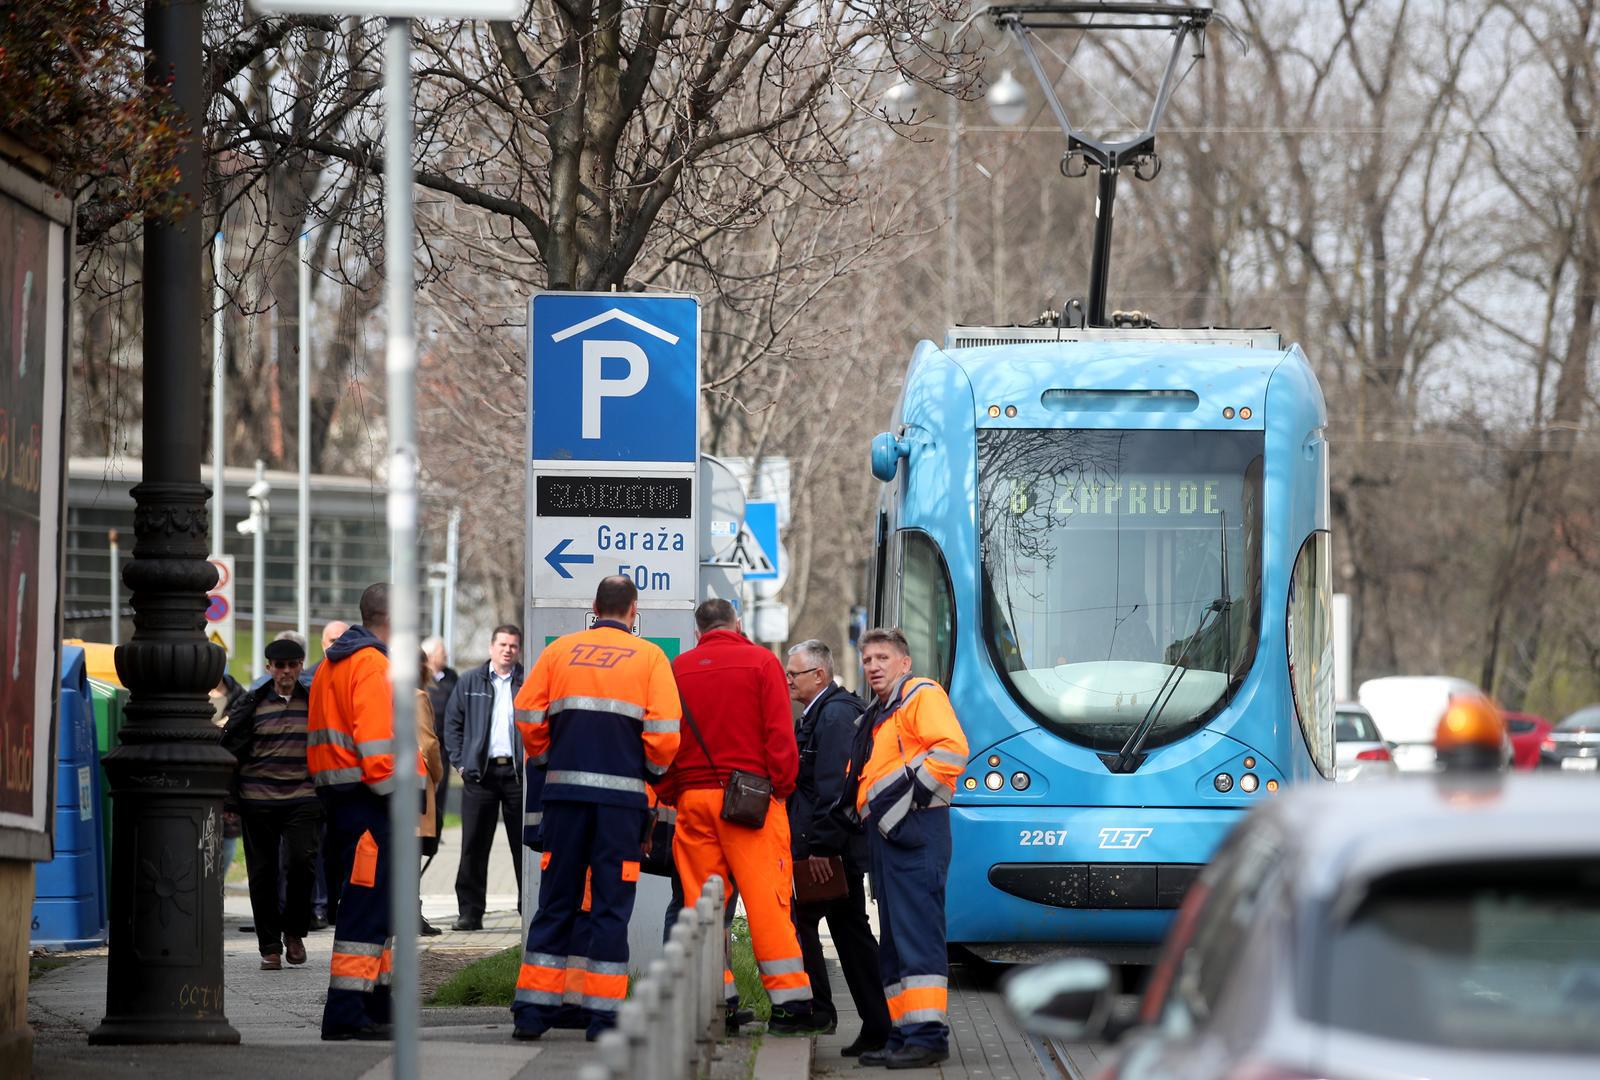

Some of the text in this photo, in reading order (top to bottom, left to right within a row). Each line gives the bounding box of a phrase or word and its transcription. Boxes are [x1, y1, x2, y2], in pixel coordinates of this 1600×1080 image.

[582, 340, 650, 439] P
[597, 524, 684, 551] Garaža
[569, 643, 637, 669] ZET
[1019, 830, 1068, 846] 2267
[1099, 827, 1154, 849] ZET
